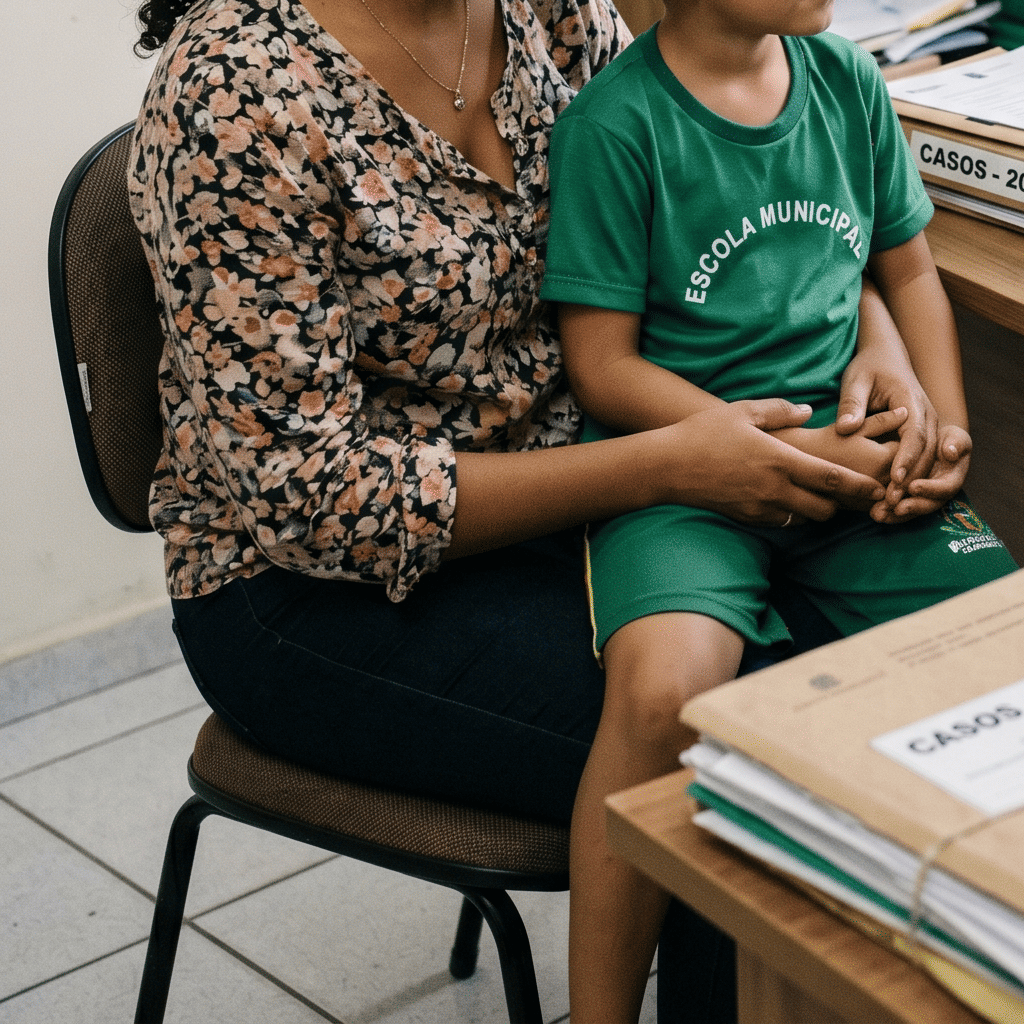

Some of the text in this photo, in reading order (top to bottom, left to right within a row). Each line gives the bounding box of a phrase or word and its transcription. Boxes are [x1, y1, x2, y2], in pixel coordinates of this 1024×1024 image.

[920, 144, 986, 179] CASOS
[685, 200, 863, 304] ESCOLA MUNICIPAL
[908, 705, 1023, 754] CASOS
